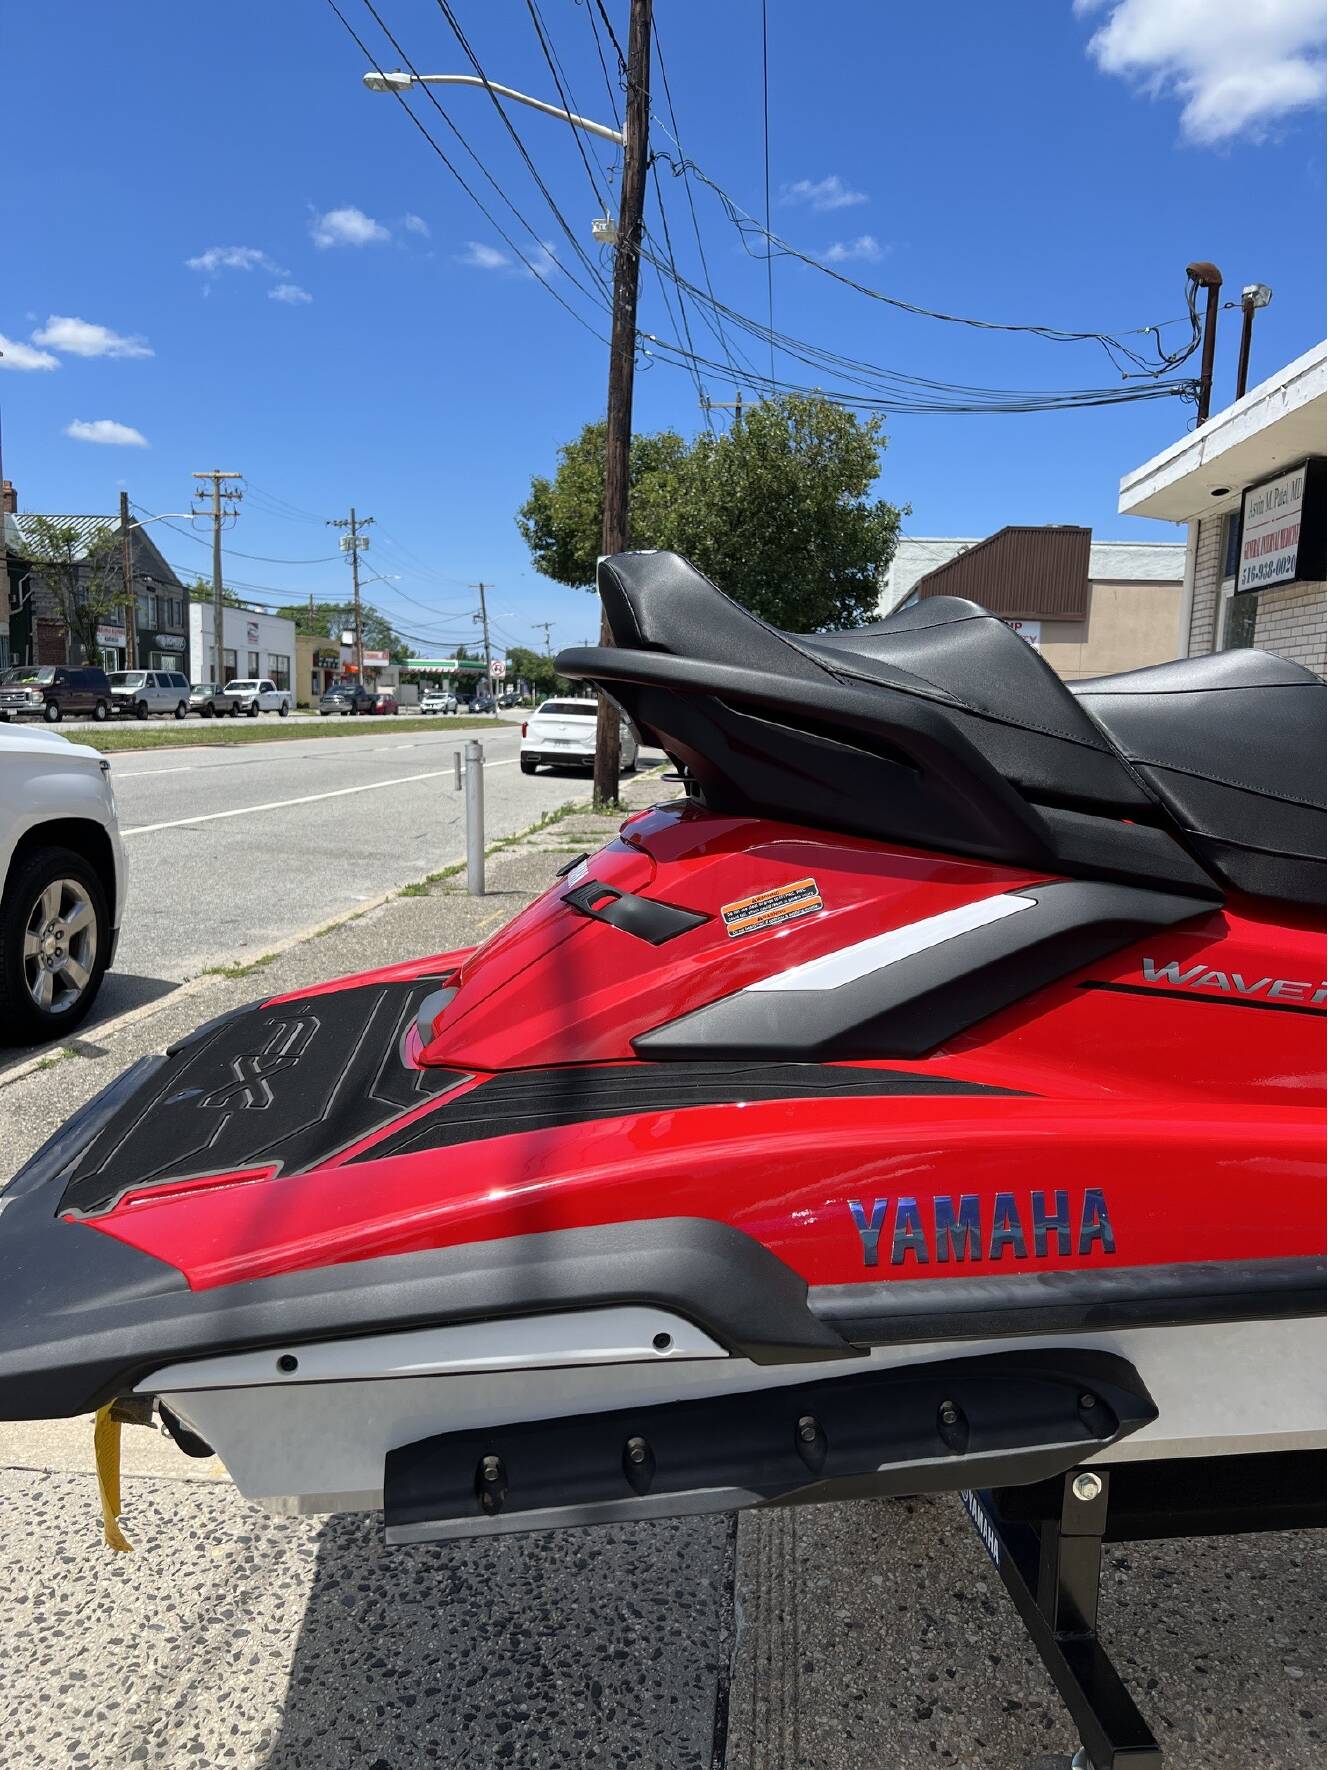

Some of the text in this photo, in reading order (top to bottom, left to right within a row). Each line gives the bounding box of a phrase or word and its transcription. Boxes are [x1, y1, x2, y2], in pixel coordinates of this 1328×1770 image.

[1241, 554, 1297, 585] 516-938-0020
[847, 1187, 1117, 1267] YAMAHA
[968, 1488, 999, 1565] YAMAHA
